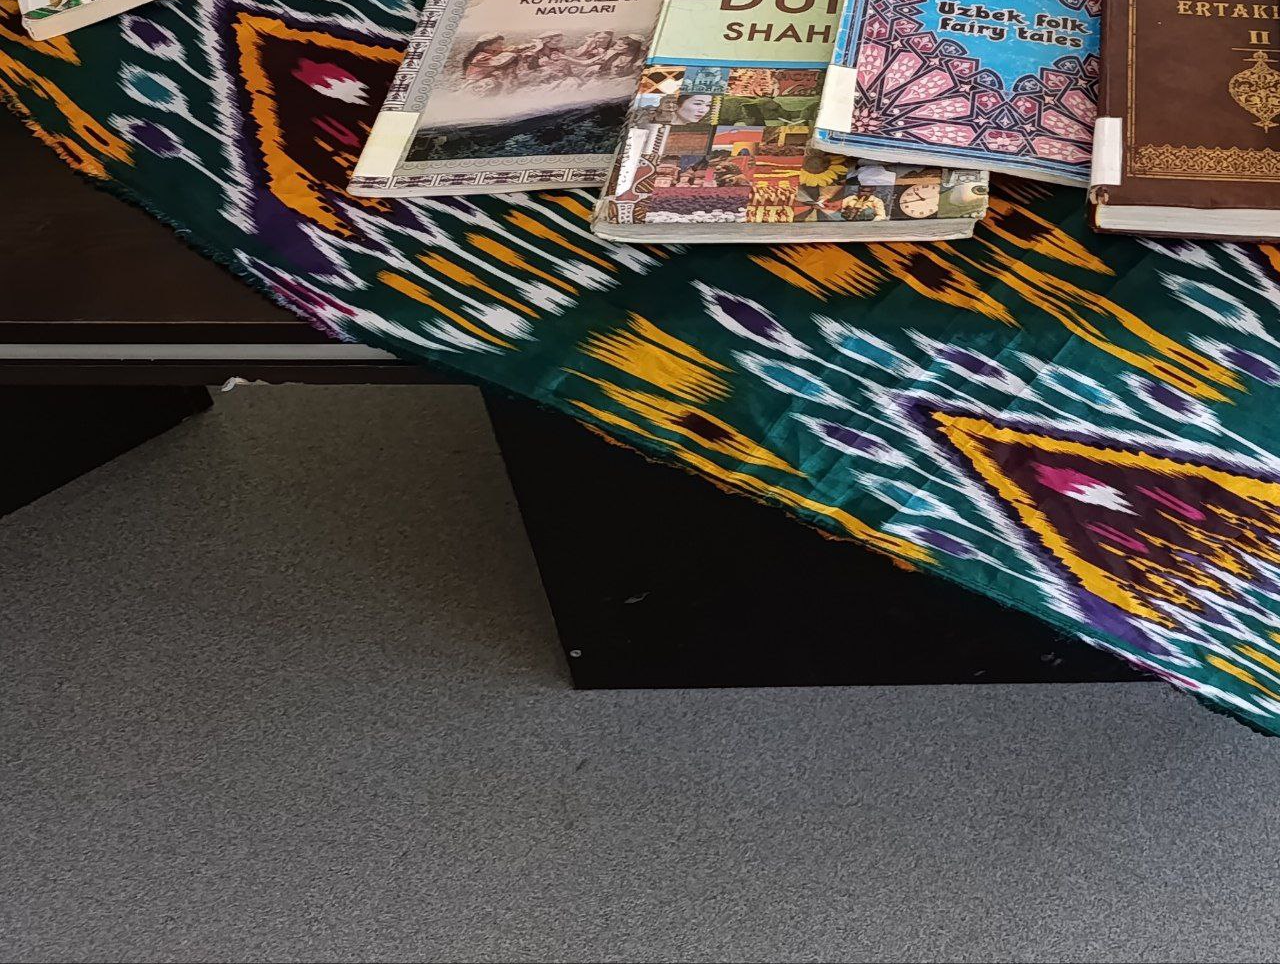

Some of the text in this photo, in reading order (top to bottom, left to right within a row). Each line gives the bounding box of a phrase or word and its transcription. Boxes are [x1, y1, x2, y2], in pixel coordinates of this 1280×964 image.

[535, 4, 616, 16] NAVOLARI
[937, 0, 1029, 25] Uzbek
[723, 22, 836, 43] SHAH
[1016, 26, 1083, 48] tales
